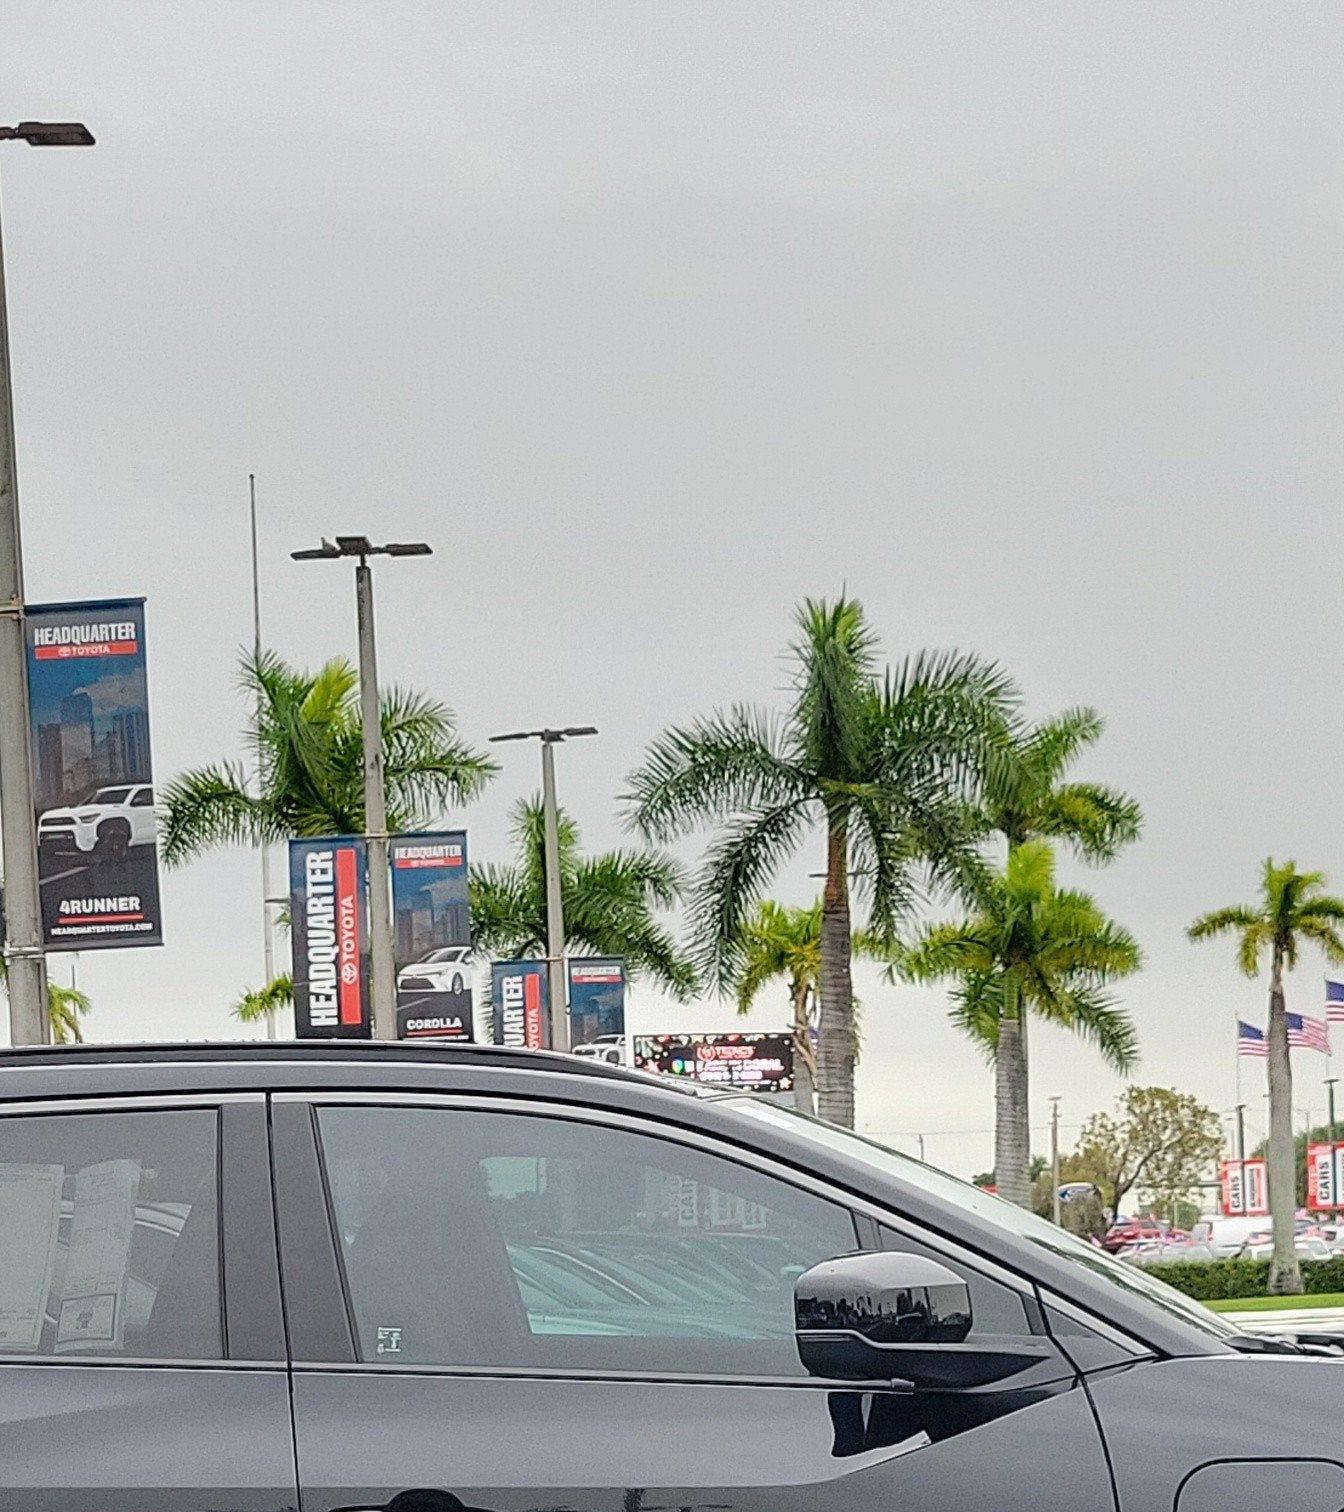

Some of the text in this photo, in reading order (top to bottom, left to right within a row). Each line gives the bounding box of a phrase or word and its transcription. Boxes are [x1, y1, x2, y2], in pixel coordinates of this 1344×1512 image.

[34, 622, 136, 646] HEADQUARTER
[72, 644, 111, 656] TOYOTA
[59, 896, 141, 915] 4RUNNER
[306, 850, 339, 1027] HEADQUARTER
[340, 895, 357, 962] TOYOTA
[406, 1017, 463, 1030] COROLLA
[1232, 1175, 1240, 1209] CARS
[1319, 1161, 1330, 1201] CARS
